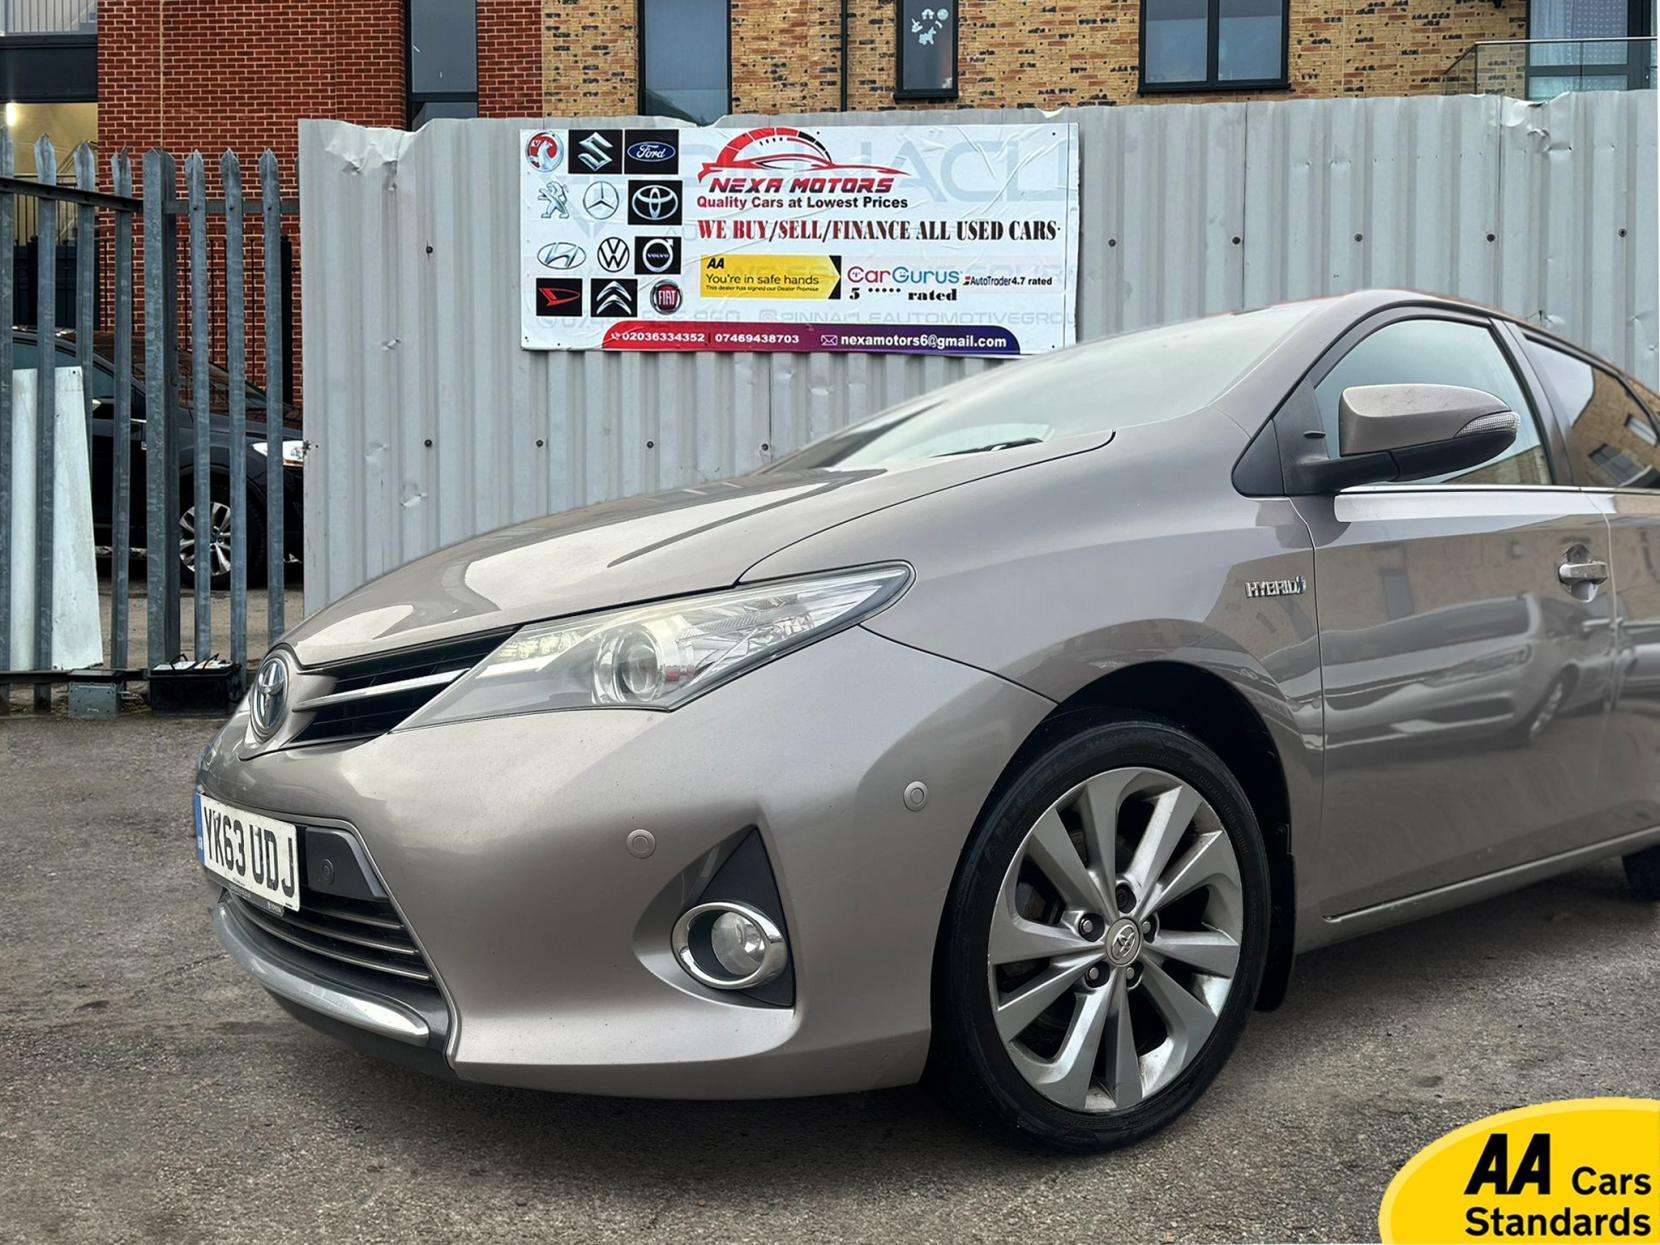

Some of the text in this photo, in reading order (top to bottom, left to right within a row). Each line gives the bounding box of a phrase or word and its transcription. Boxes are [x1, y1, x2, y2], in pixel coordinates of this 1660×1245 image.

[636, 144, 666, 158] Ford
[709, 178, 894, 193] NEXA MOTORS
[697, 196, 908, 210] Quality Cars at Lowest Prices
[697, 220, 727, 240] WE
[916, 220, 950, 240] ALL
[956, 220, 1004, 241] USED
[1008, 220, 1057, 241] CARS
[707, 257, 725, 269] AA
[706, 273, 820, 285] You're in safe hands
[847, 266, 960, 284] CarGurus
[1028, 277, 1053, 286] rated
[658, 290, 676, 306] FIAT
[849, 287, 957, 301] 5 rated
[622, 332, 800, 344] 02036334352 07469438703
[841, 333, 1007, 349] nexamotors6@gmail.com
[1245, 579, 1300, 597] HYBRID
[203, 806, 295, 898] YK63 UDJ
